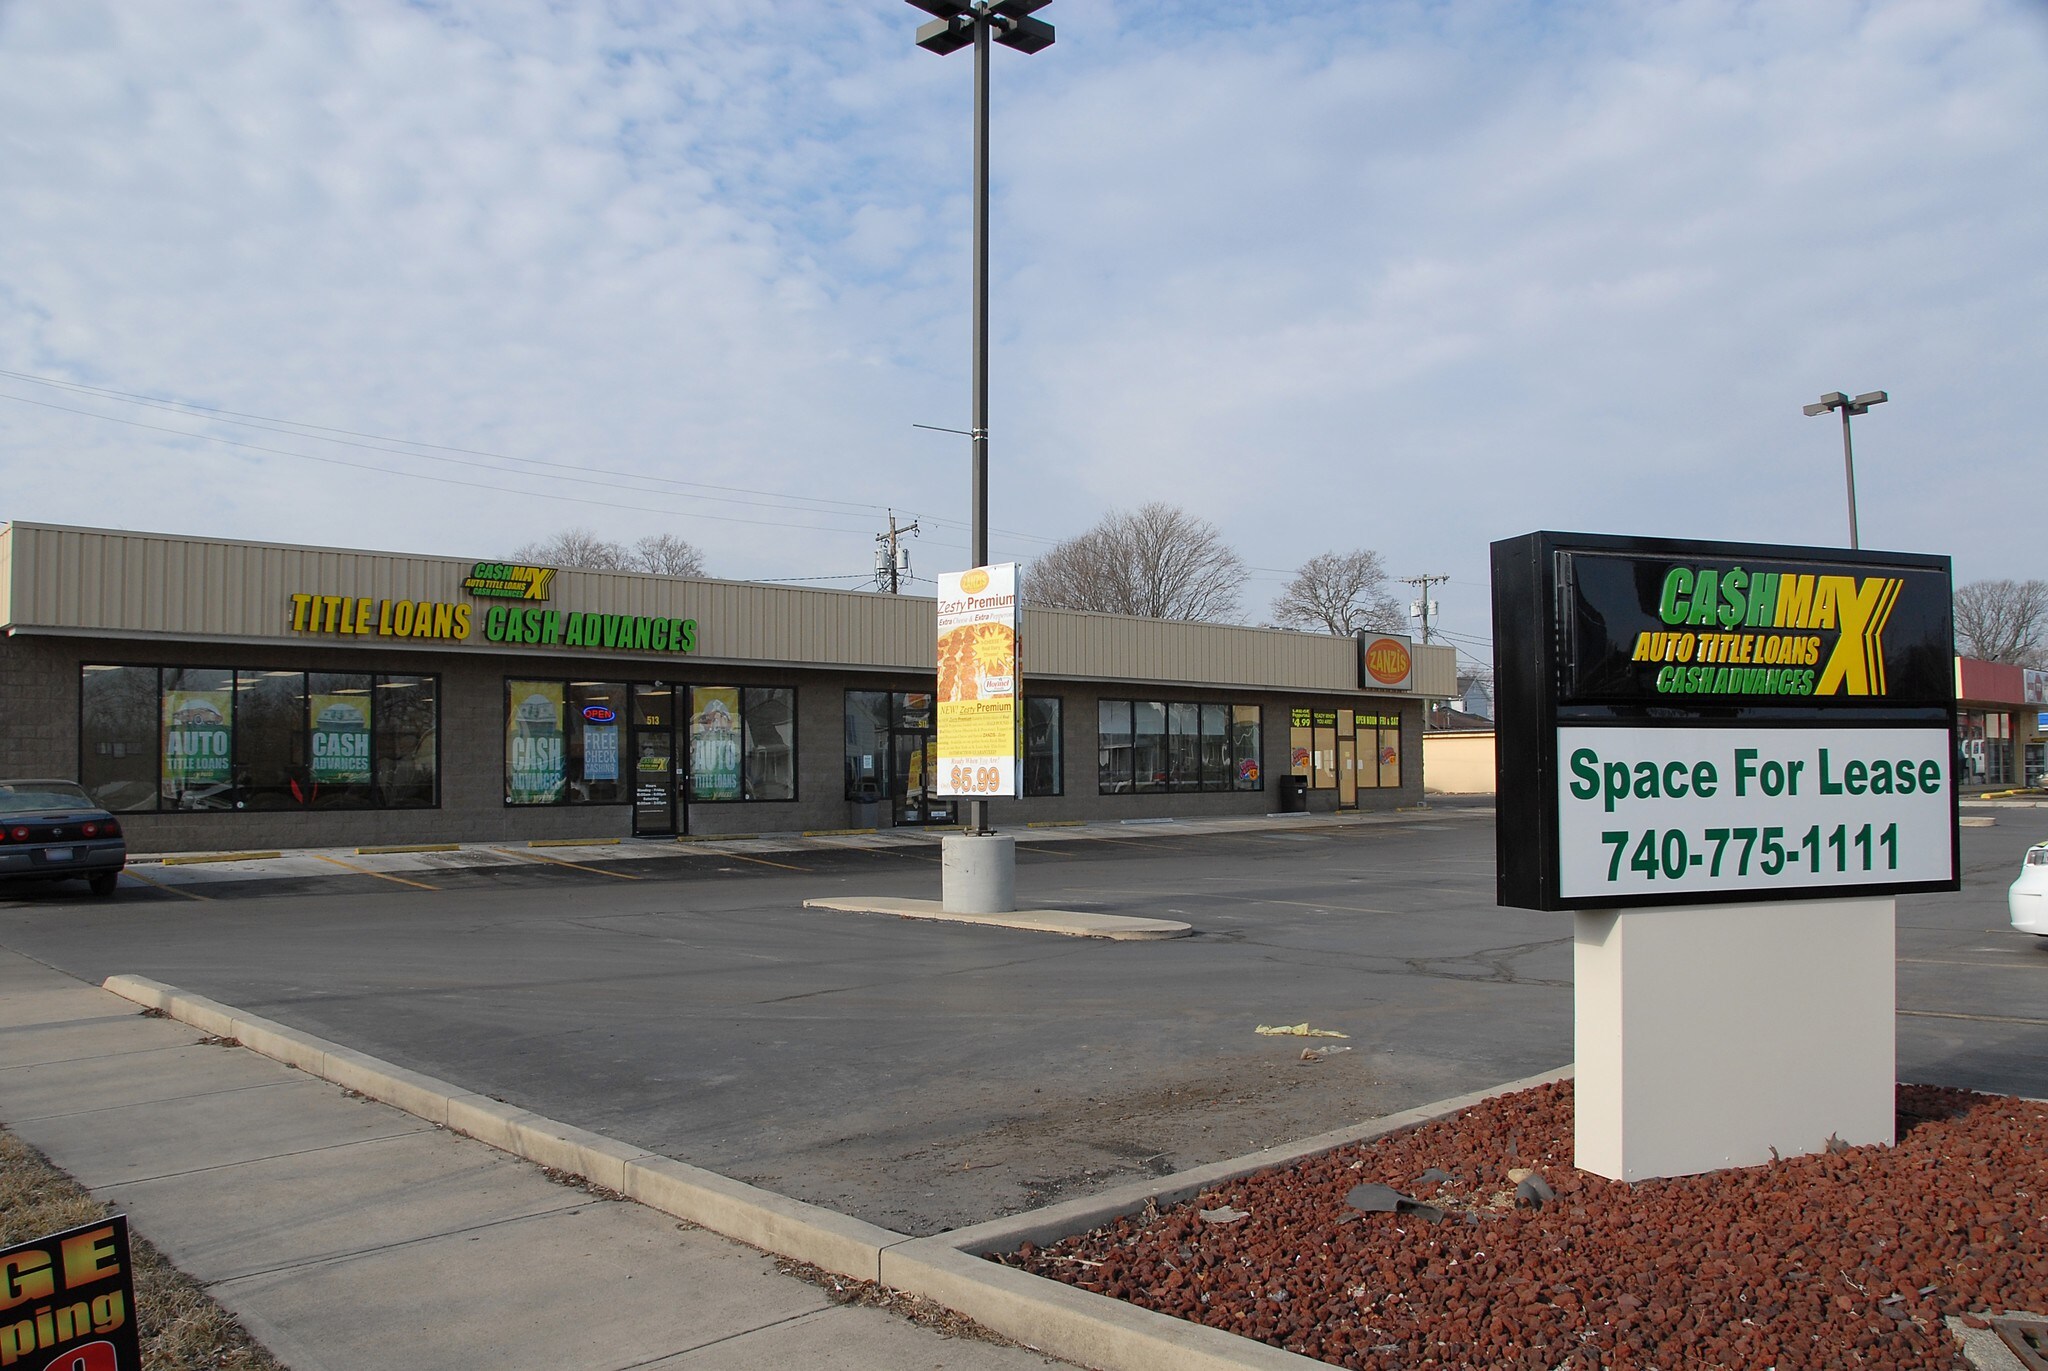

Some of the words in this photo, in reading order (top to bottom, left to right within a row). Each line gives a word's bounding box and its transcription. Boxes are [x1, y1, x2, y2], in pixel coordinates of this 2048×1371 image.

[465, 579, 485, 588] AUTO
[486, 580, 504, 589] TITLE
[504, 582, 527, 591] LOANS
[291, 593, 372, 635] TITLE
[378, 598, 473, 640] LOANS
[938, 600, 966, 615] Zesty
[967, 593, 1015, 610] Premium
[485, 605, 561, 645] CASH
[564, 611, 698, 652] ADVANCES
[1632, 632, 1696, 663] AUTO
[1697, 633, 1755, 665] TITLE
[1752, 635, 1822, 666] LOANS
[1656, 666, 1717, 694] CASH
[1712, 667, 1816, 697] ADVANCES
[585, 709, 612, 719] OPEN
[646, 715, 660, 725] 513
[976, 702, 1012, 713] Premium
[167, 731, 228, 756] AUTO
[312, 732, 369, 757] CASH
[512, 736, 561, 771] CASH
[585, 732, 616, 750] FREE
[167, 757, 194, 770] TITLE
[196, 757, 229, 770] LOANS
[312, 757, 368, 770] ADVANCES
[585, 750, 616, 763] CHECK
[695, 739, 736, 771] AUTO
[512, 772, 561, 790] ADVANCES
[695, 774, 713, 788] TITLE
[715, 773, 737, 789] LOANS
[950, 764, 1000, 794] $5.99
[1569, 747, 1719, 812] Space
[1734, 748, 1805, 797] For
[1818, 748, 1942, 796] Lease
[1602, 822, 1898, 881] 740-775-1111
[0, 1226, 120, 1311] GE
[0, 1290, 125, 1367] ping
